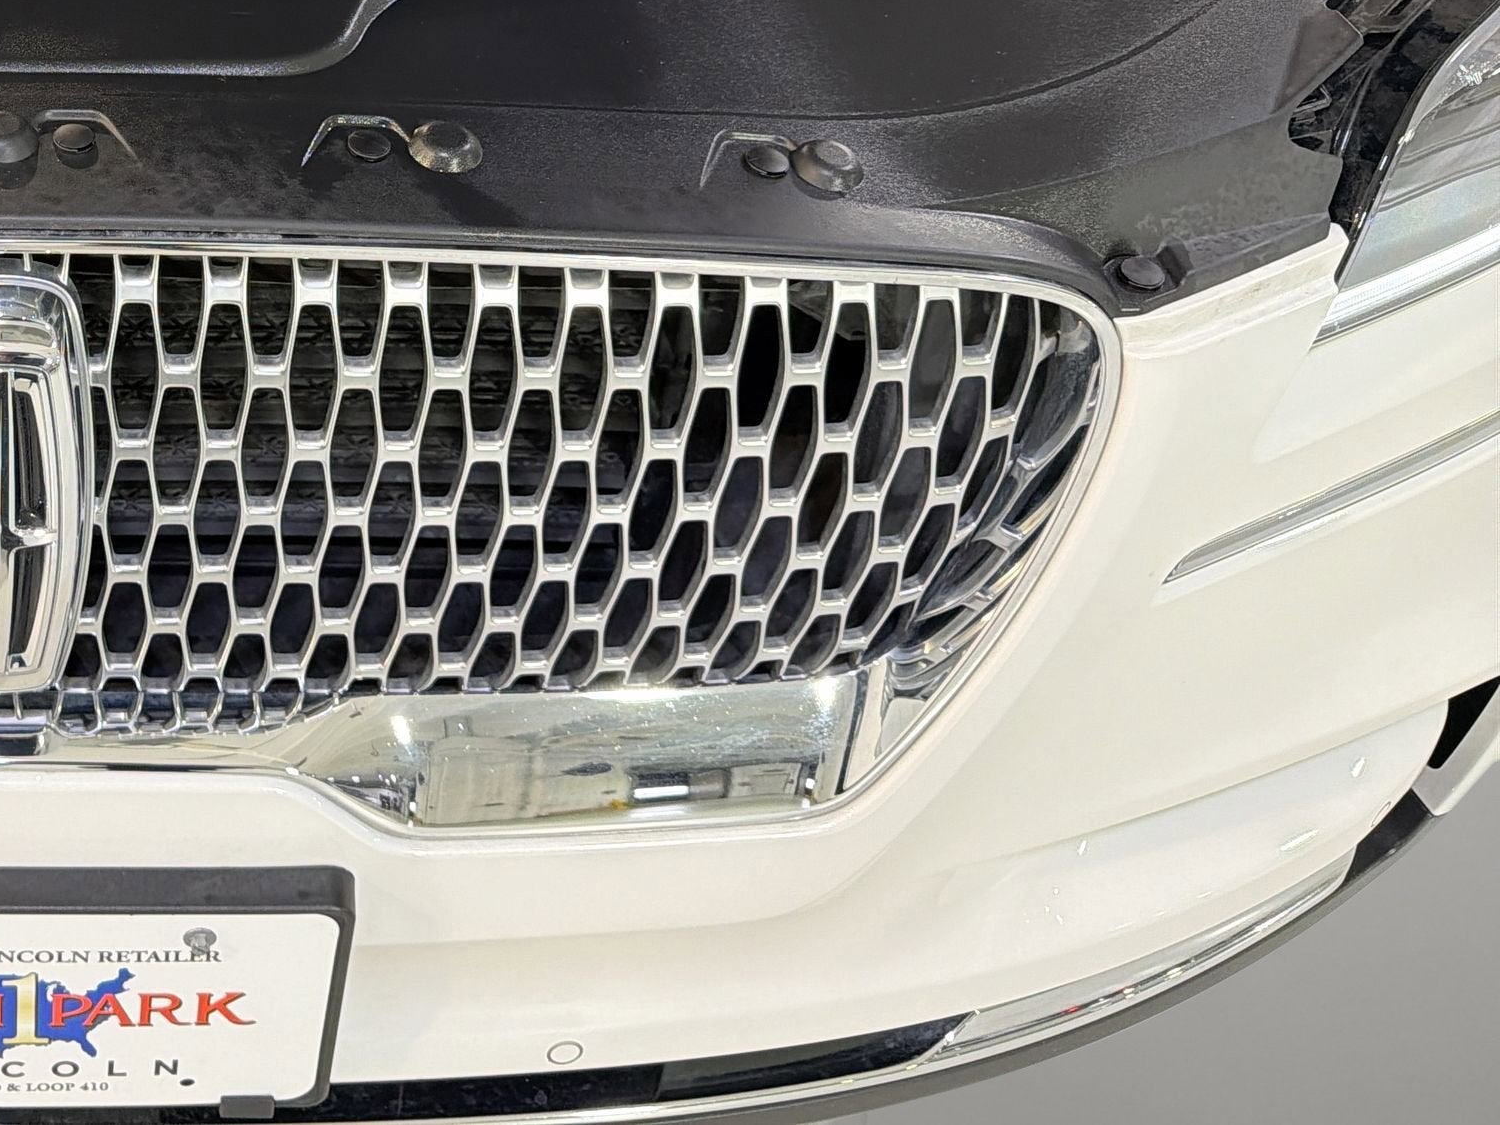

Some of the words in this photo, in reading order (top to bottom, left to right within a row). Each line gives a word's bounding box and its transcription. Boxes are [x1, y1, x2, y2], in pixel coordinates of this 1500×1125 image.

[97, 949, 223, 963] RETAILER
[50, 991, 257, 1028] PARK
[7, 1081, 22, 1092] &
[26, 1081, 76, 1092] LOOP
[80, 1081, 110, 1092] 410
